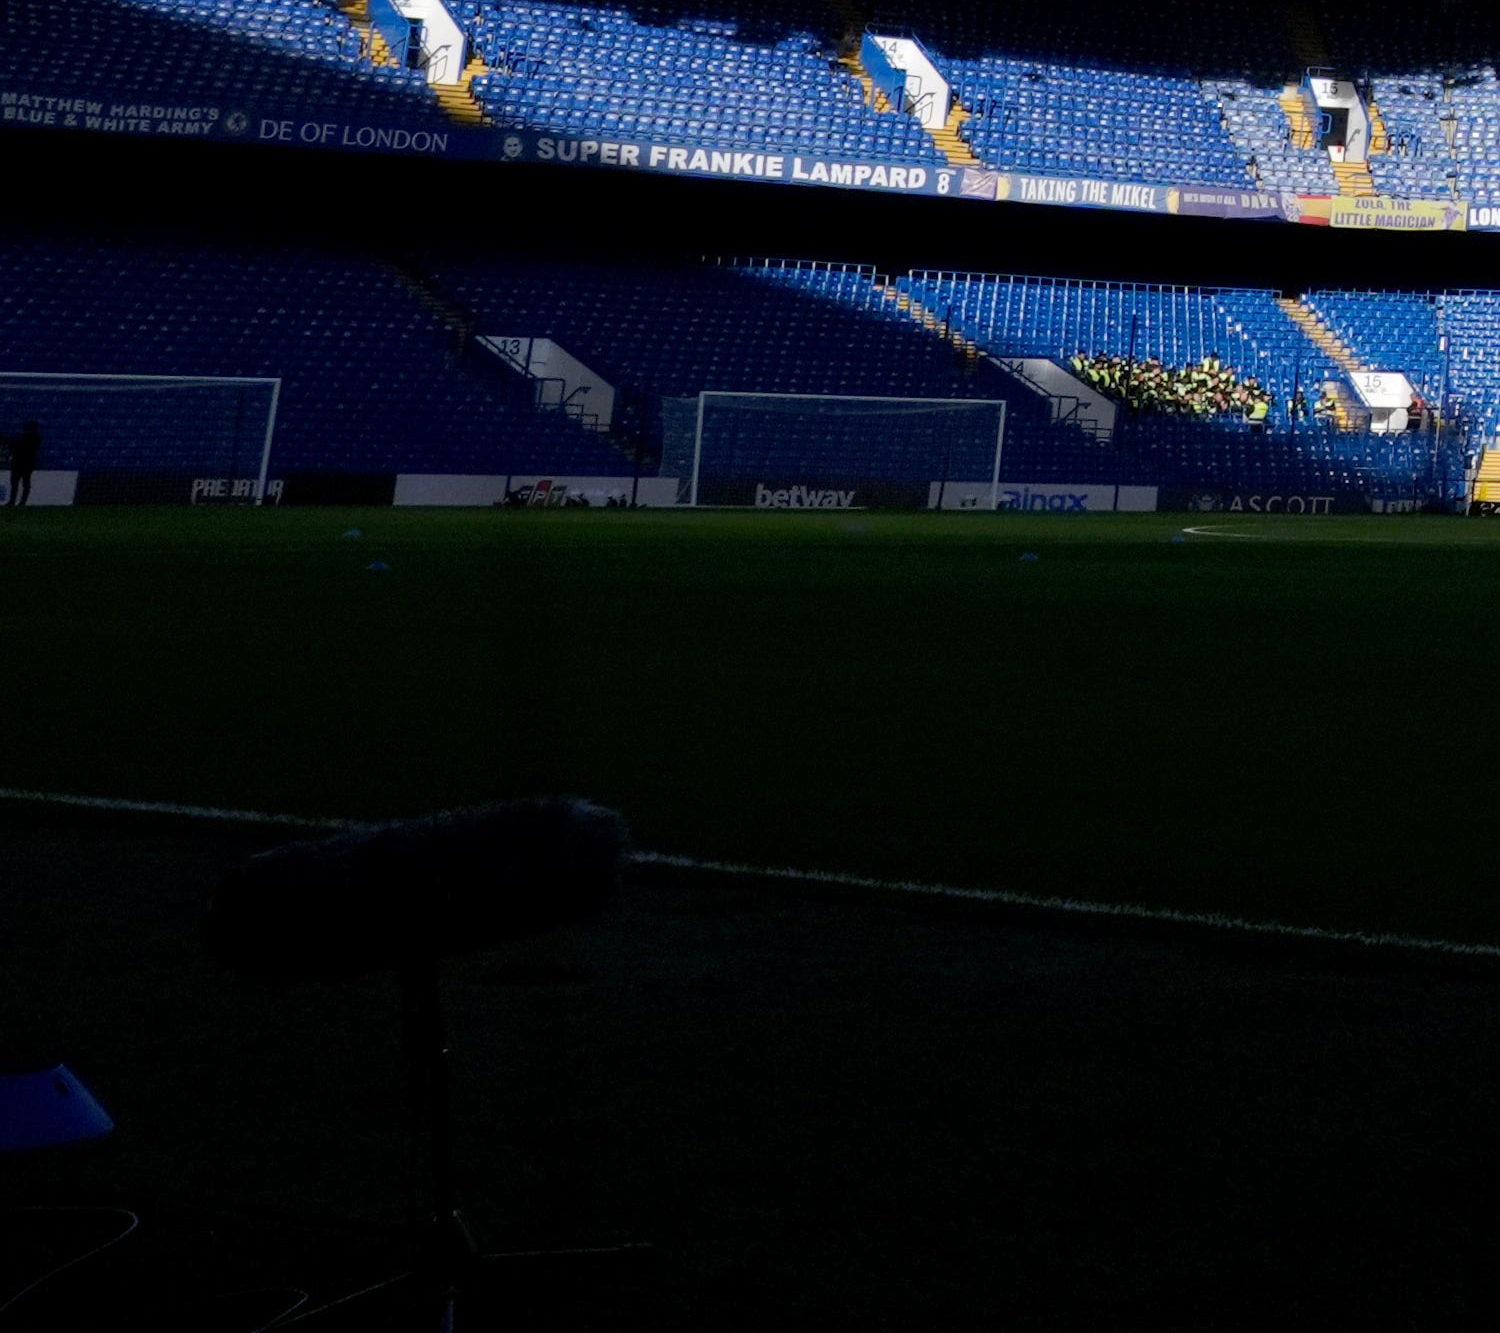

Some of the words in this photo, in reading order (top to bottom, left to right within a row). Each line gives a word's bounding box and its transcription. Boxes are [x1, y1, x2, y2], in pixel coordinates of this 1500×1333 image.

[881, 40, 897, 53] 14
[1323, 83, 1338, 94] 15
[1, 91, 103, 115] MATTHEW
[110, 104, 220, 121] HARDING'S
[3, 106, 55, 124] BLUE
[64, 113, 78, 126] &
[85, 116, 151, 132] WHITE
[155, 121, 214, 134] ARMY
[299, 120, 337, 144] OF
[342, 125, 449, 152] LONDON
[537, 137, 640, 166] SUPER
[649, 145, 783, 177] FRANKIE
[792, 158, 927, 190] LAMPARD
[937, 174, 950, 194] 8
[1020, 178, 1078, 203] TAKING
[1081, 180, 1109, 204] THE
[1111, 182, 1156, 209] MIKEL
[1390, 200, 1412, 211] THE
[1334, 212, 1374, 226] LITTLE
[1375, 214, 1436, 229] MAGICIAN
[500, 340, 520, 354] 13
[1364, 375, 1381, 388] 15
[754, 483, 856, 510] betway
[1229, 495, 1335, 514] ASCOTT
